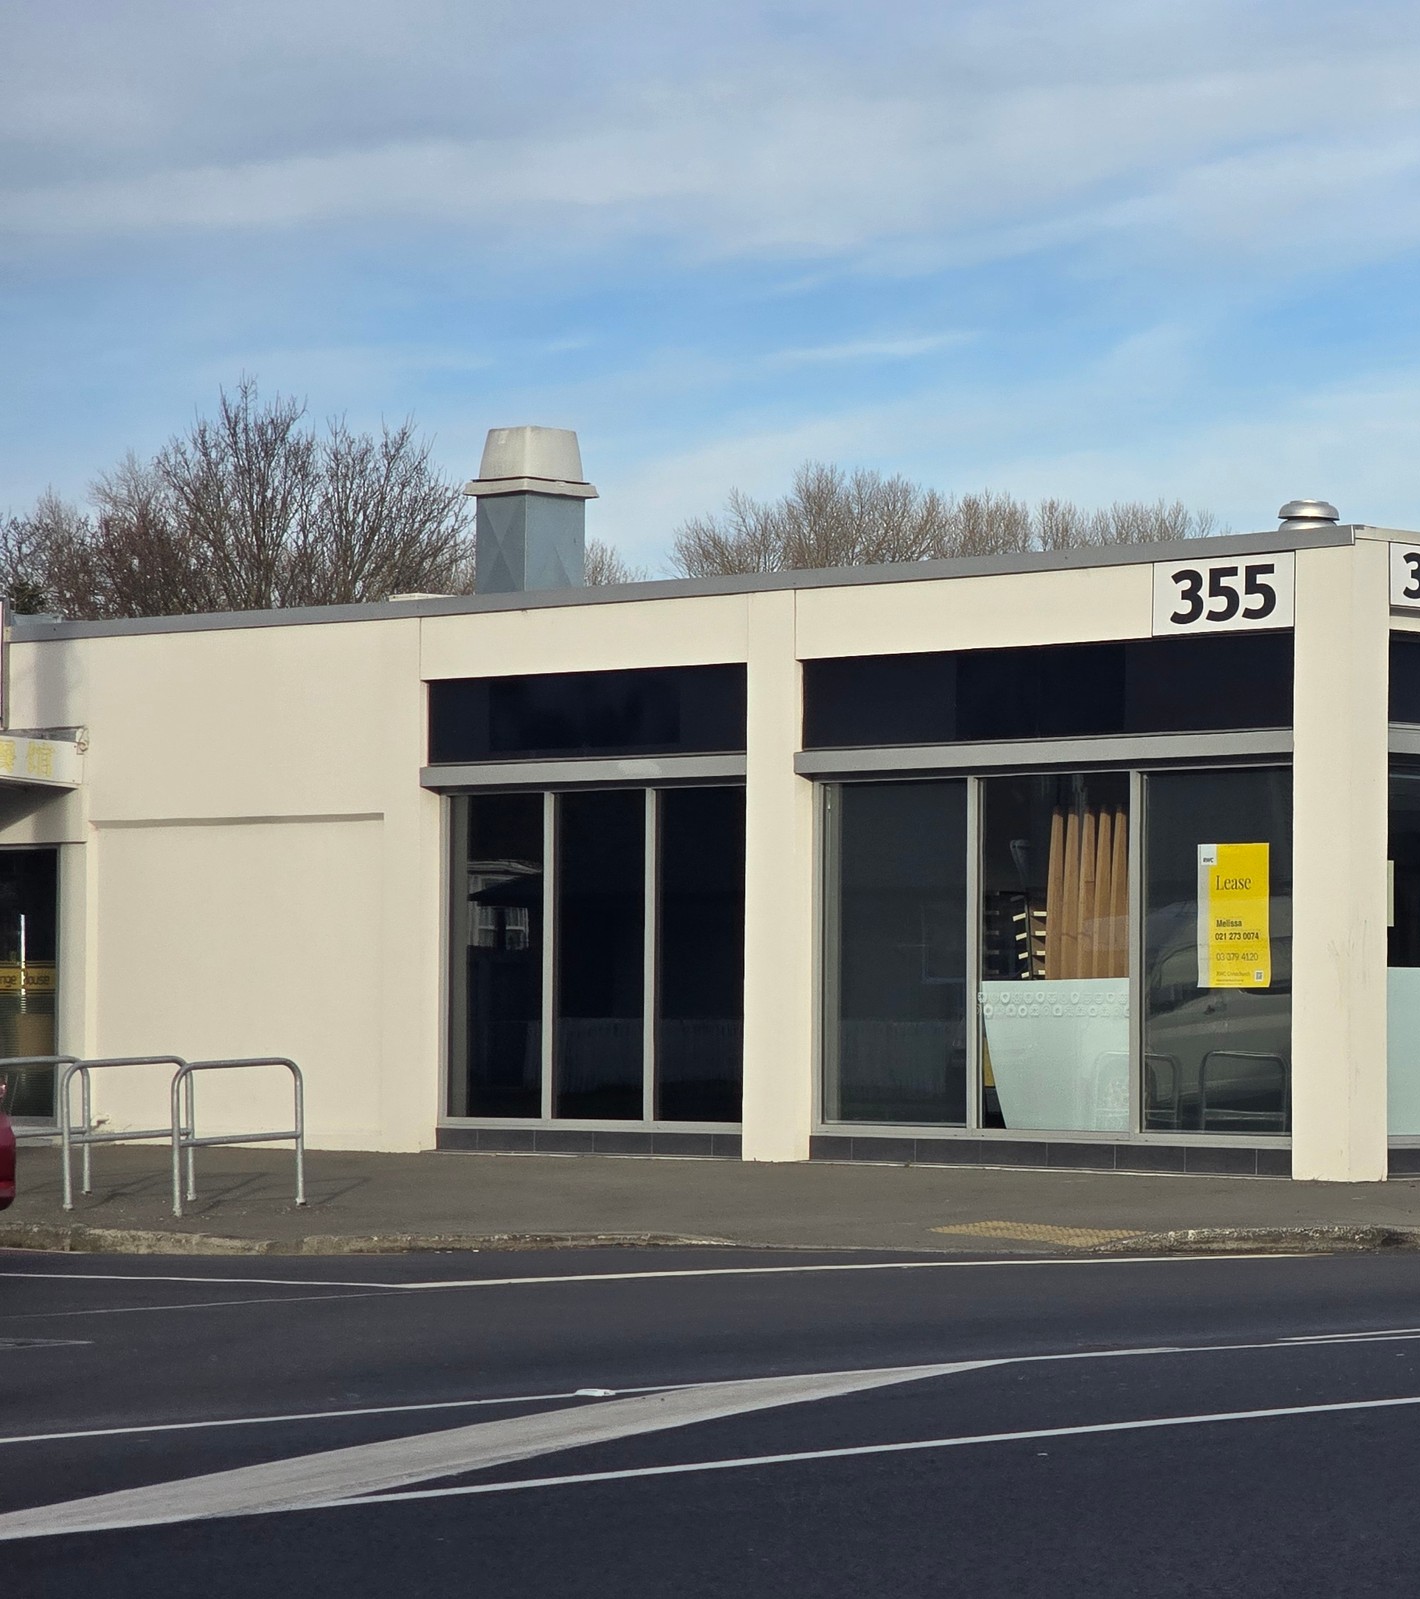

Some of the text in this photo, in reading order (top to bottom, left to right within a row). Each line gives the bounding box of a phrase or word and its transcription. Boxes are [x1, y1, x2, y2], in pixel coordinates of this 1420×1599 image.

[1170, 563, 1277, 625] 355
[1216, 875, 1252, 891] Lease
[1216, 919, 1242, 928] Melissa
[1214, 932, 1260, 941] 021 273 0074
